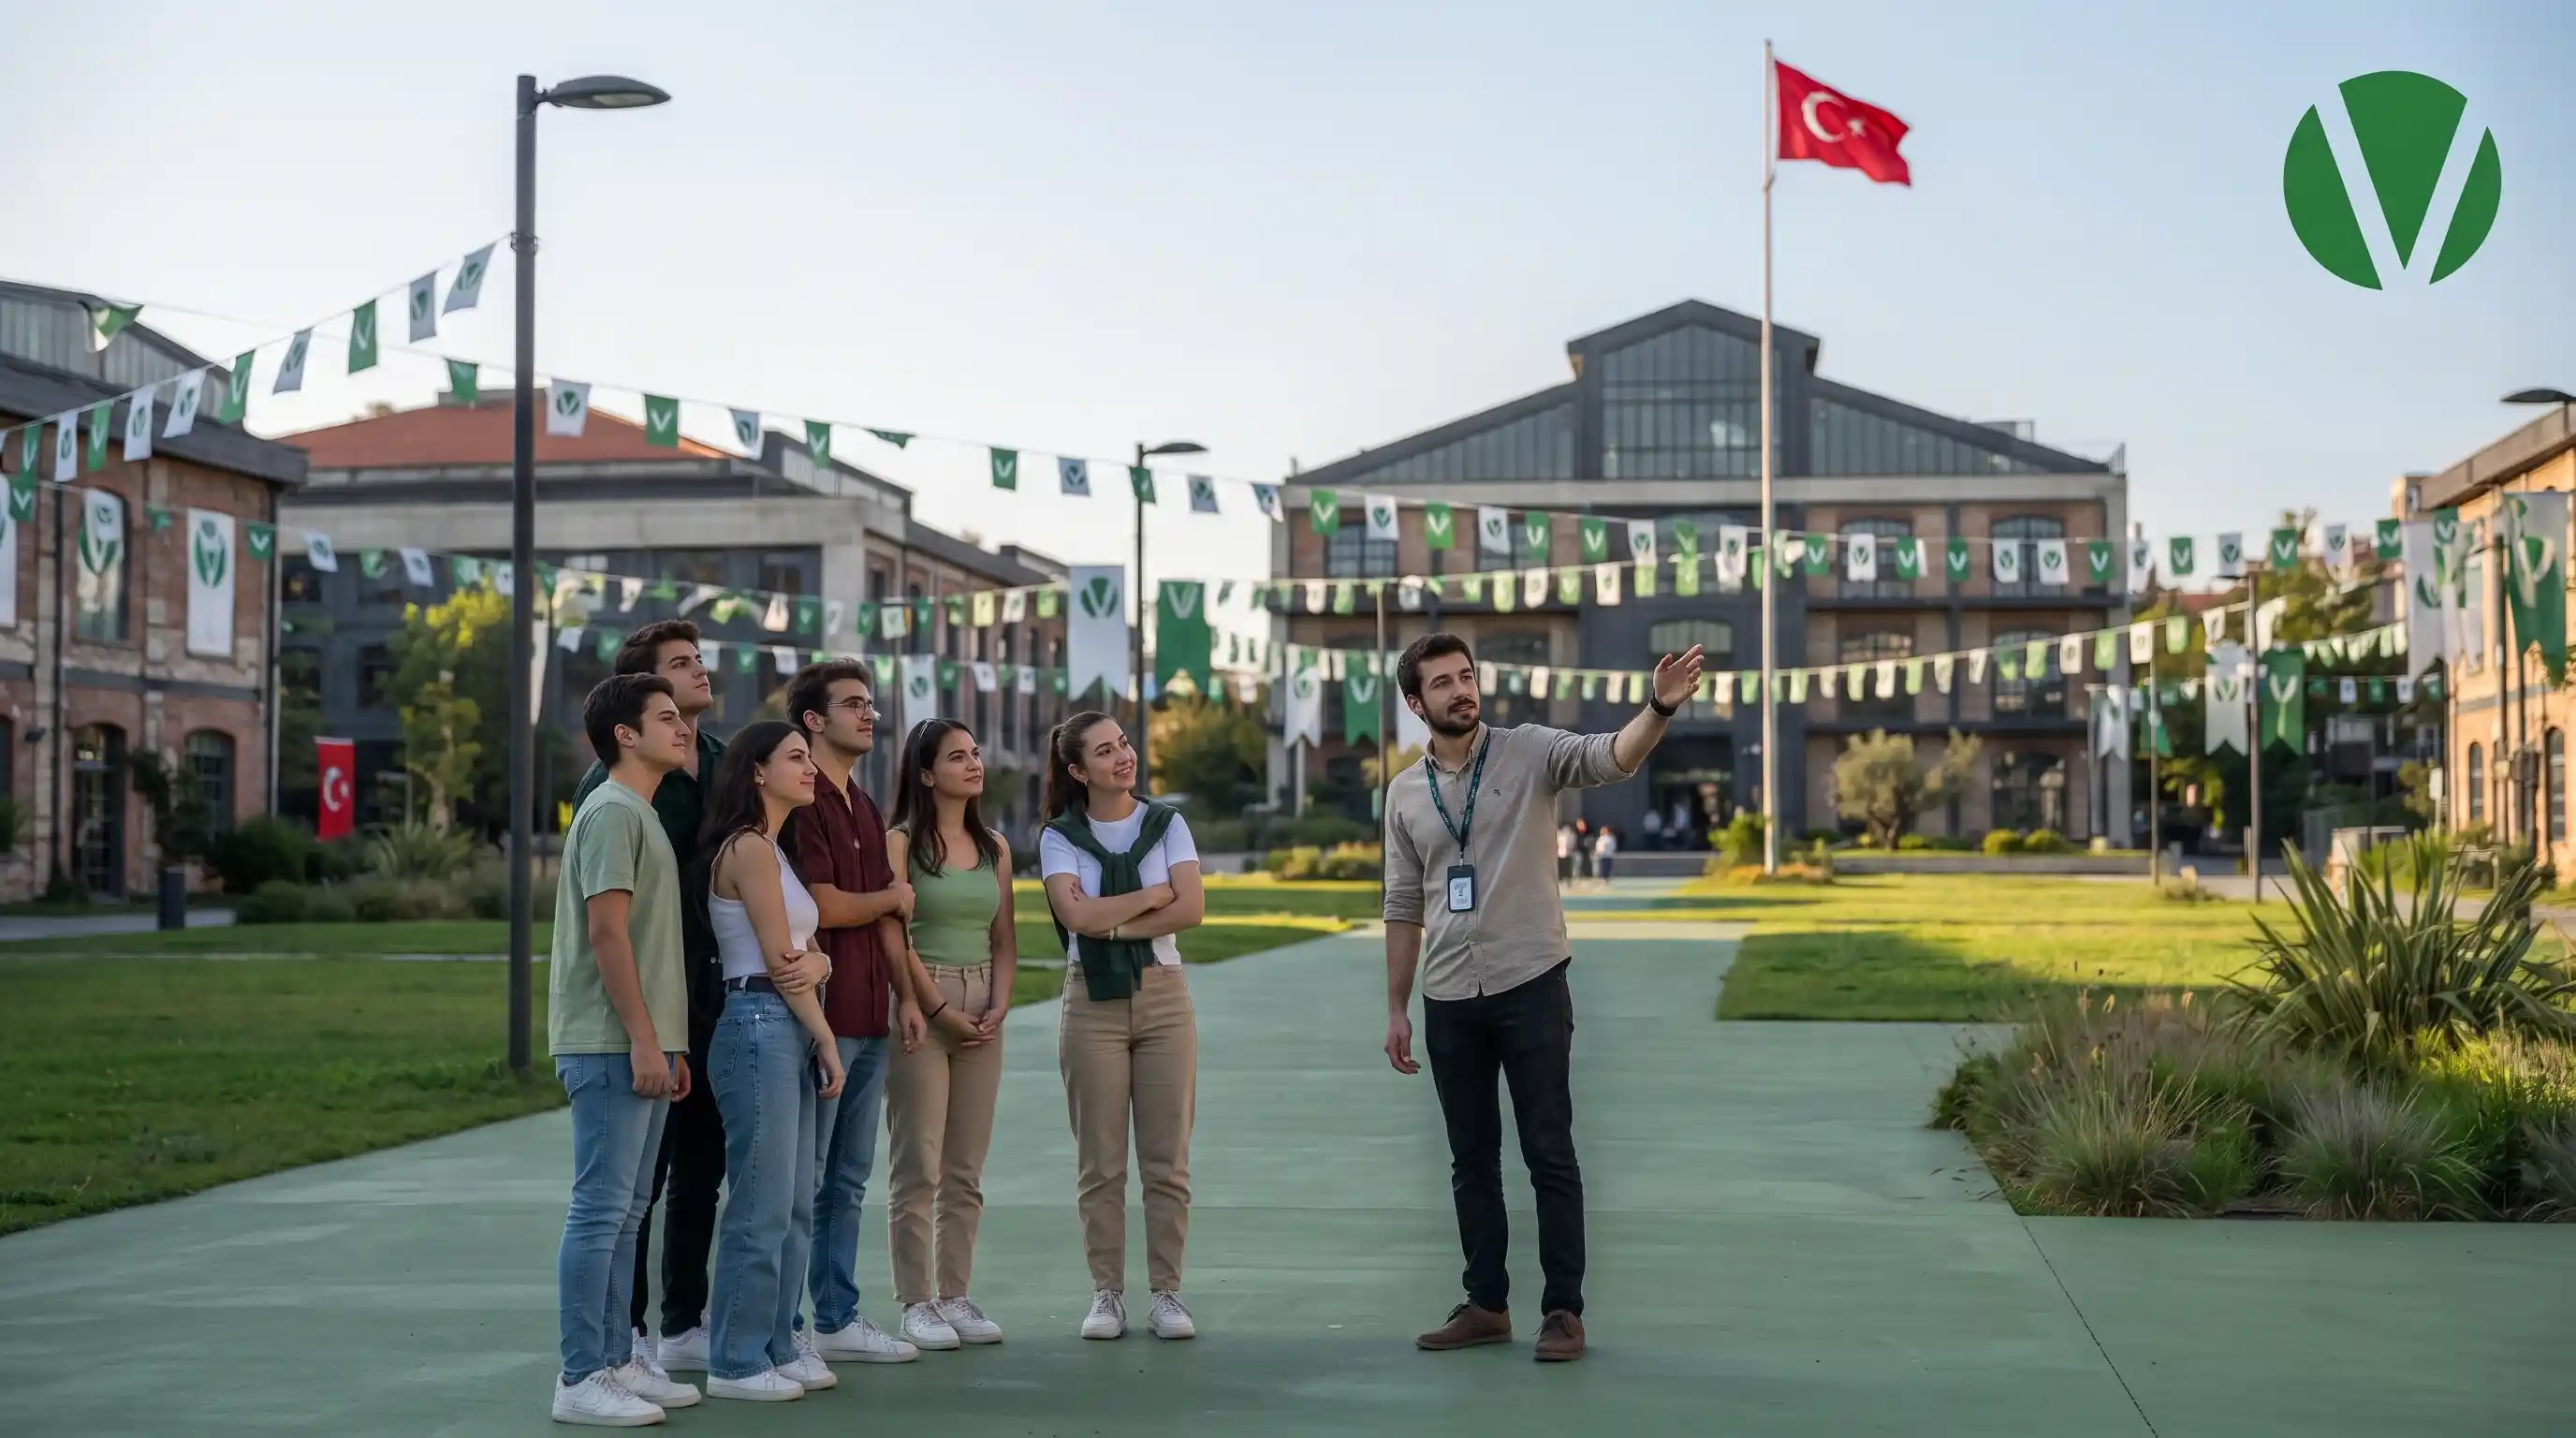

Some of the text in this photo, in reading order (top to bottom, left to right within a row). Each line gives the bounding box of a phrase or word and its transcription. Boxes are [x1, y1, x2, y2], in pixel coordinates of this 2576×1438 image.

[651, 408, 672, 433] V
[809, 433, 827, 455] V
[994, 459, 1015, 478] V
[13, 489, 32, 510] V
[1313, 501, 1336, 522] V
[1427, 512, 1451, 536] V
[250, 534, 270, 551] V
[1585, 529, 1604, 552] V
[2276, 537, 2294, 561] V
[1808, 545, 1826, 565] V
[1898, 549, 1915, 569] V
[1949, 552, 1967, 570] V
[2089, 550, 2108, 572] V
[2173, 545, 2190, 564] V
[1349, 677, 1376, 704] V
